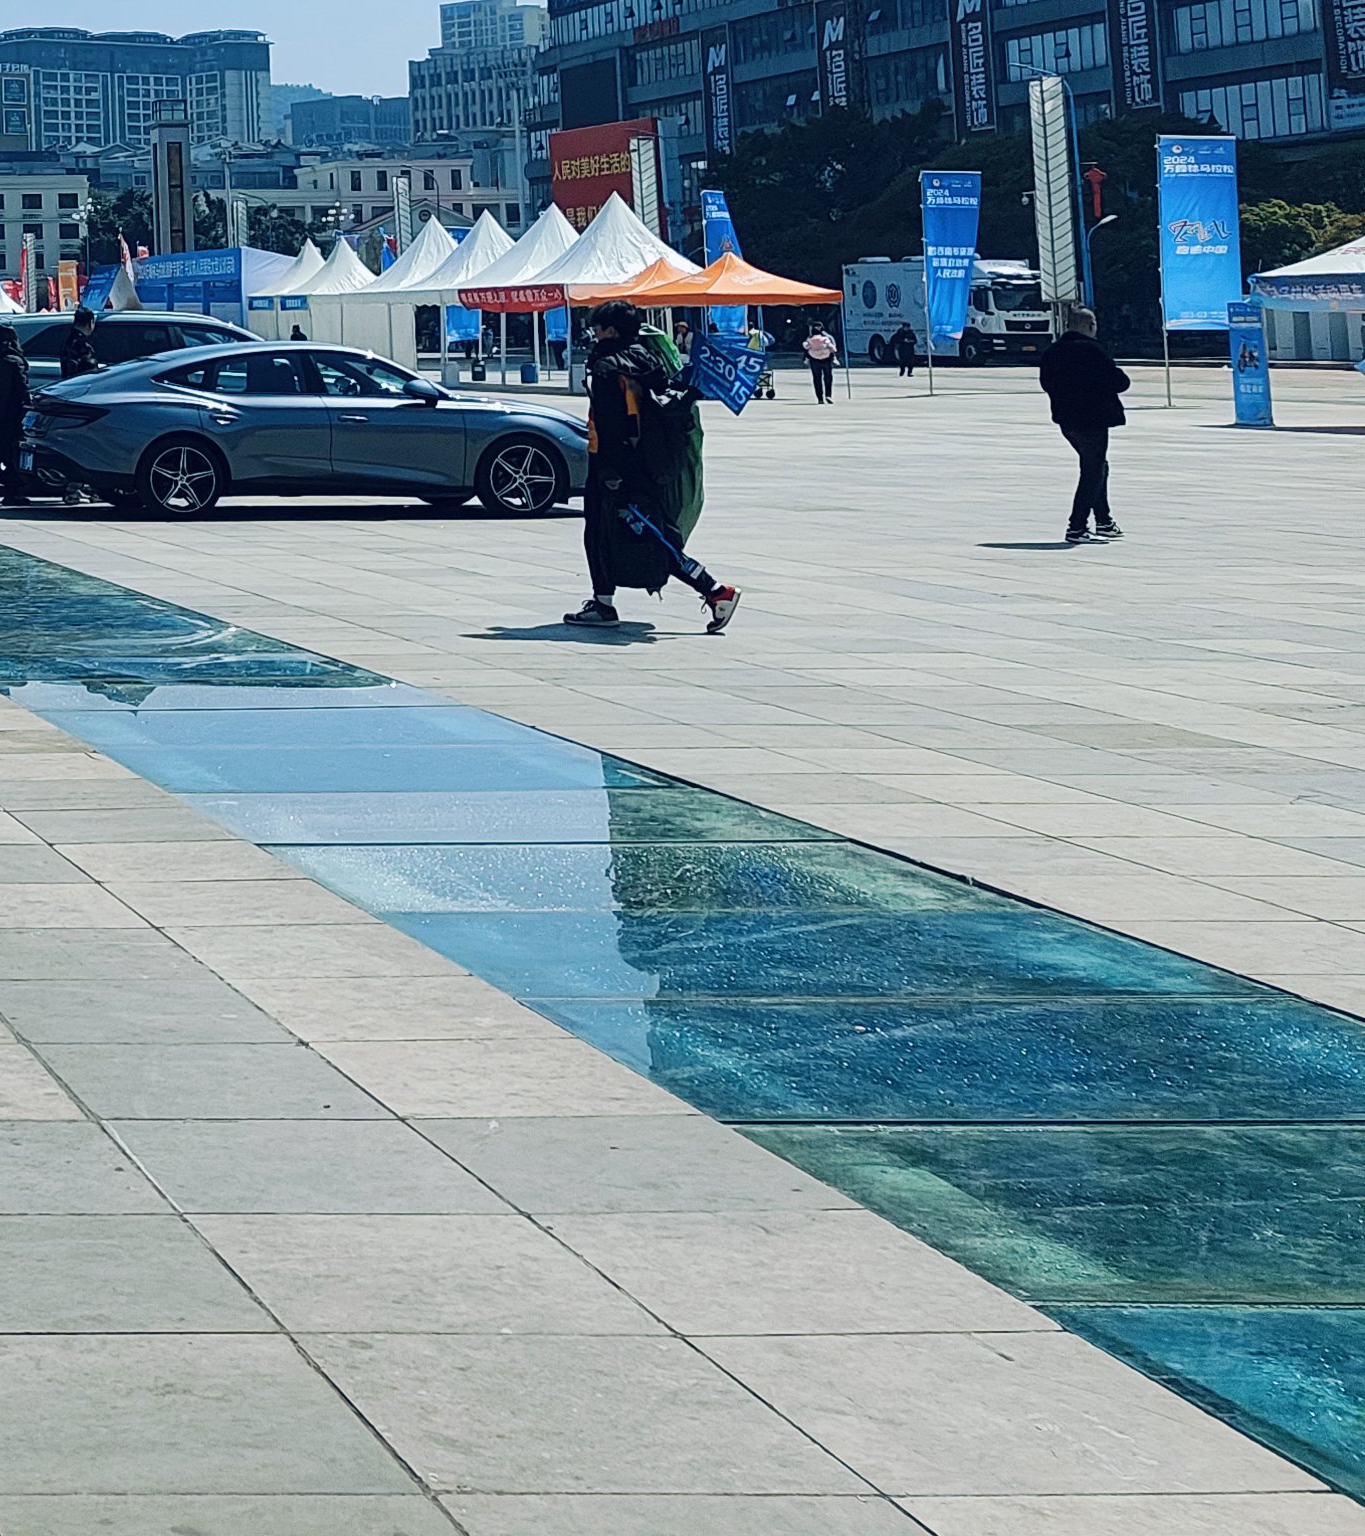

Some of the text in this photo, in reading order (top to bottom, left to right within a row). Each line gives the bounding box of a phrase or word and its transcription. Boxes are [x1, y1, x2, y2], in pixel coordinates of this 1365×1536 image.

[553, 150, 631, 182] 人民对美好生活的
[1163, 156, 1195, 164] 2024
[699, 346, 736, 382] 2:30
